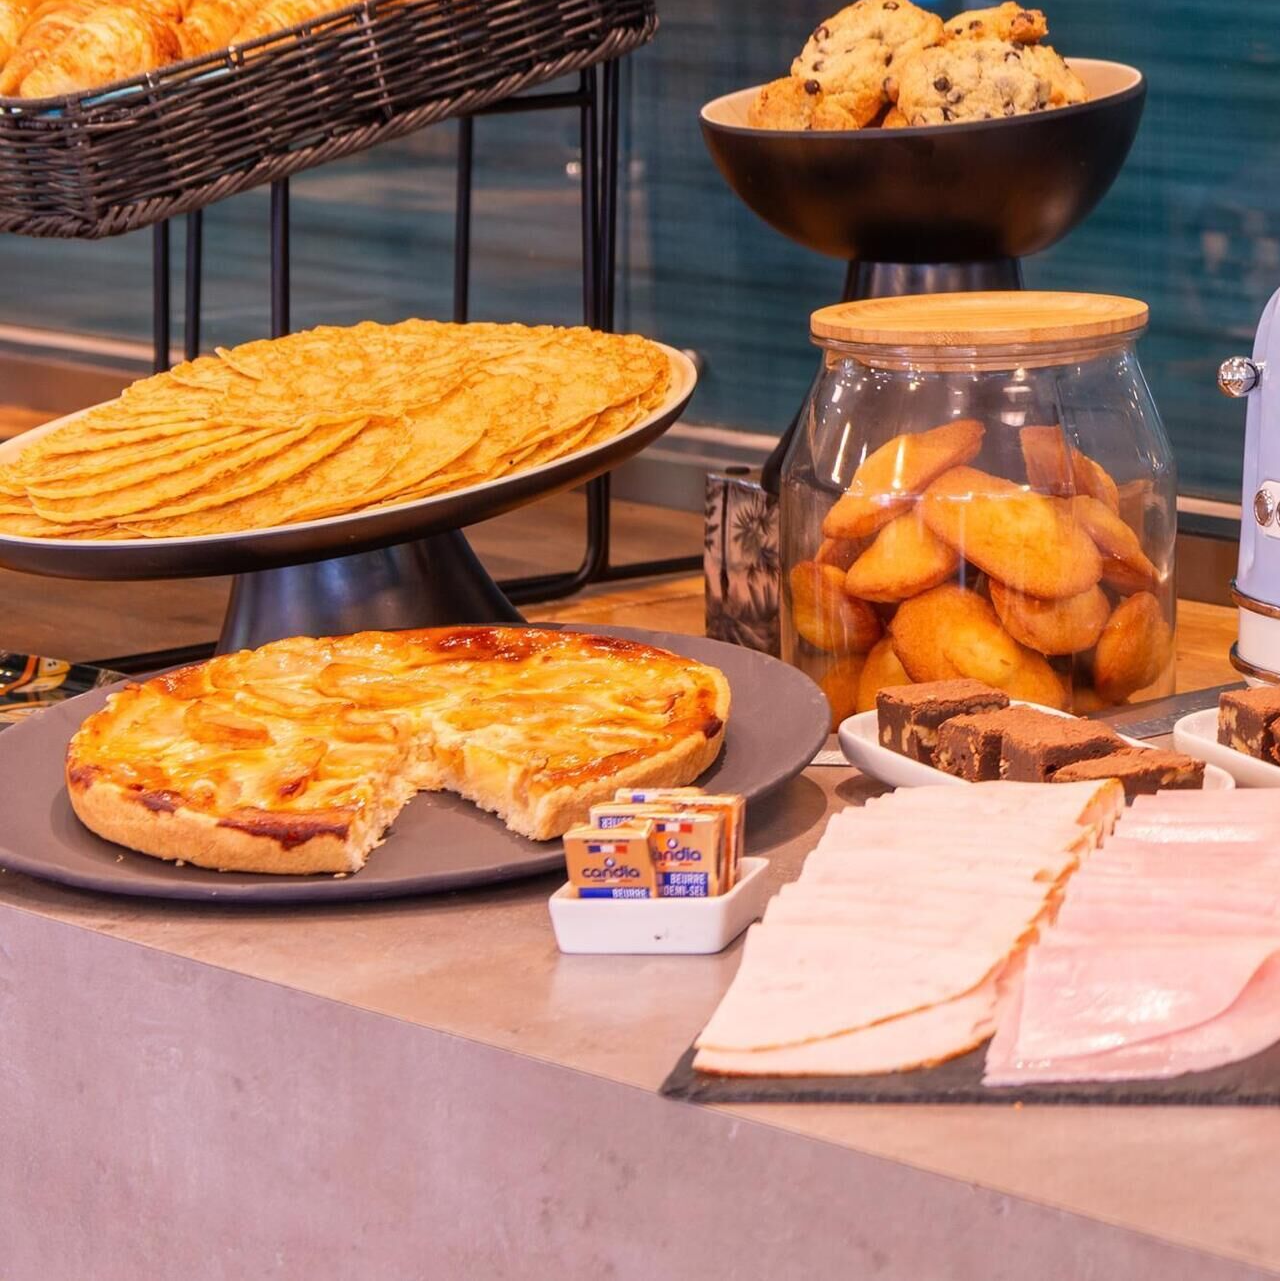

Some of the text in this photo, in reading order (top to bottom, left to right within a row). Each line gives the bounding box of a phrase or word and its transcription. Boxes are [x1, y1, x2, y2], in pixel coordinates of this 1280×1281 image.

[652, 846, 702, 862] andia
[582, 864, 640, 878] candia
[669, 873, 706, 885] BEURRE
[663, 884, 706, 897] DEMI-SEL
